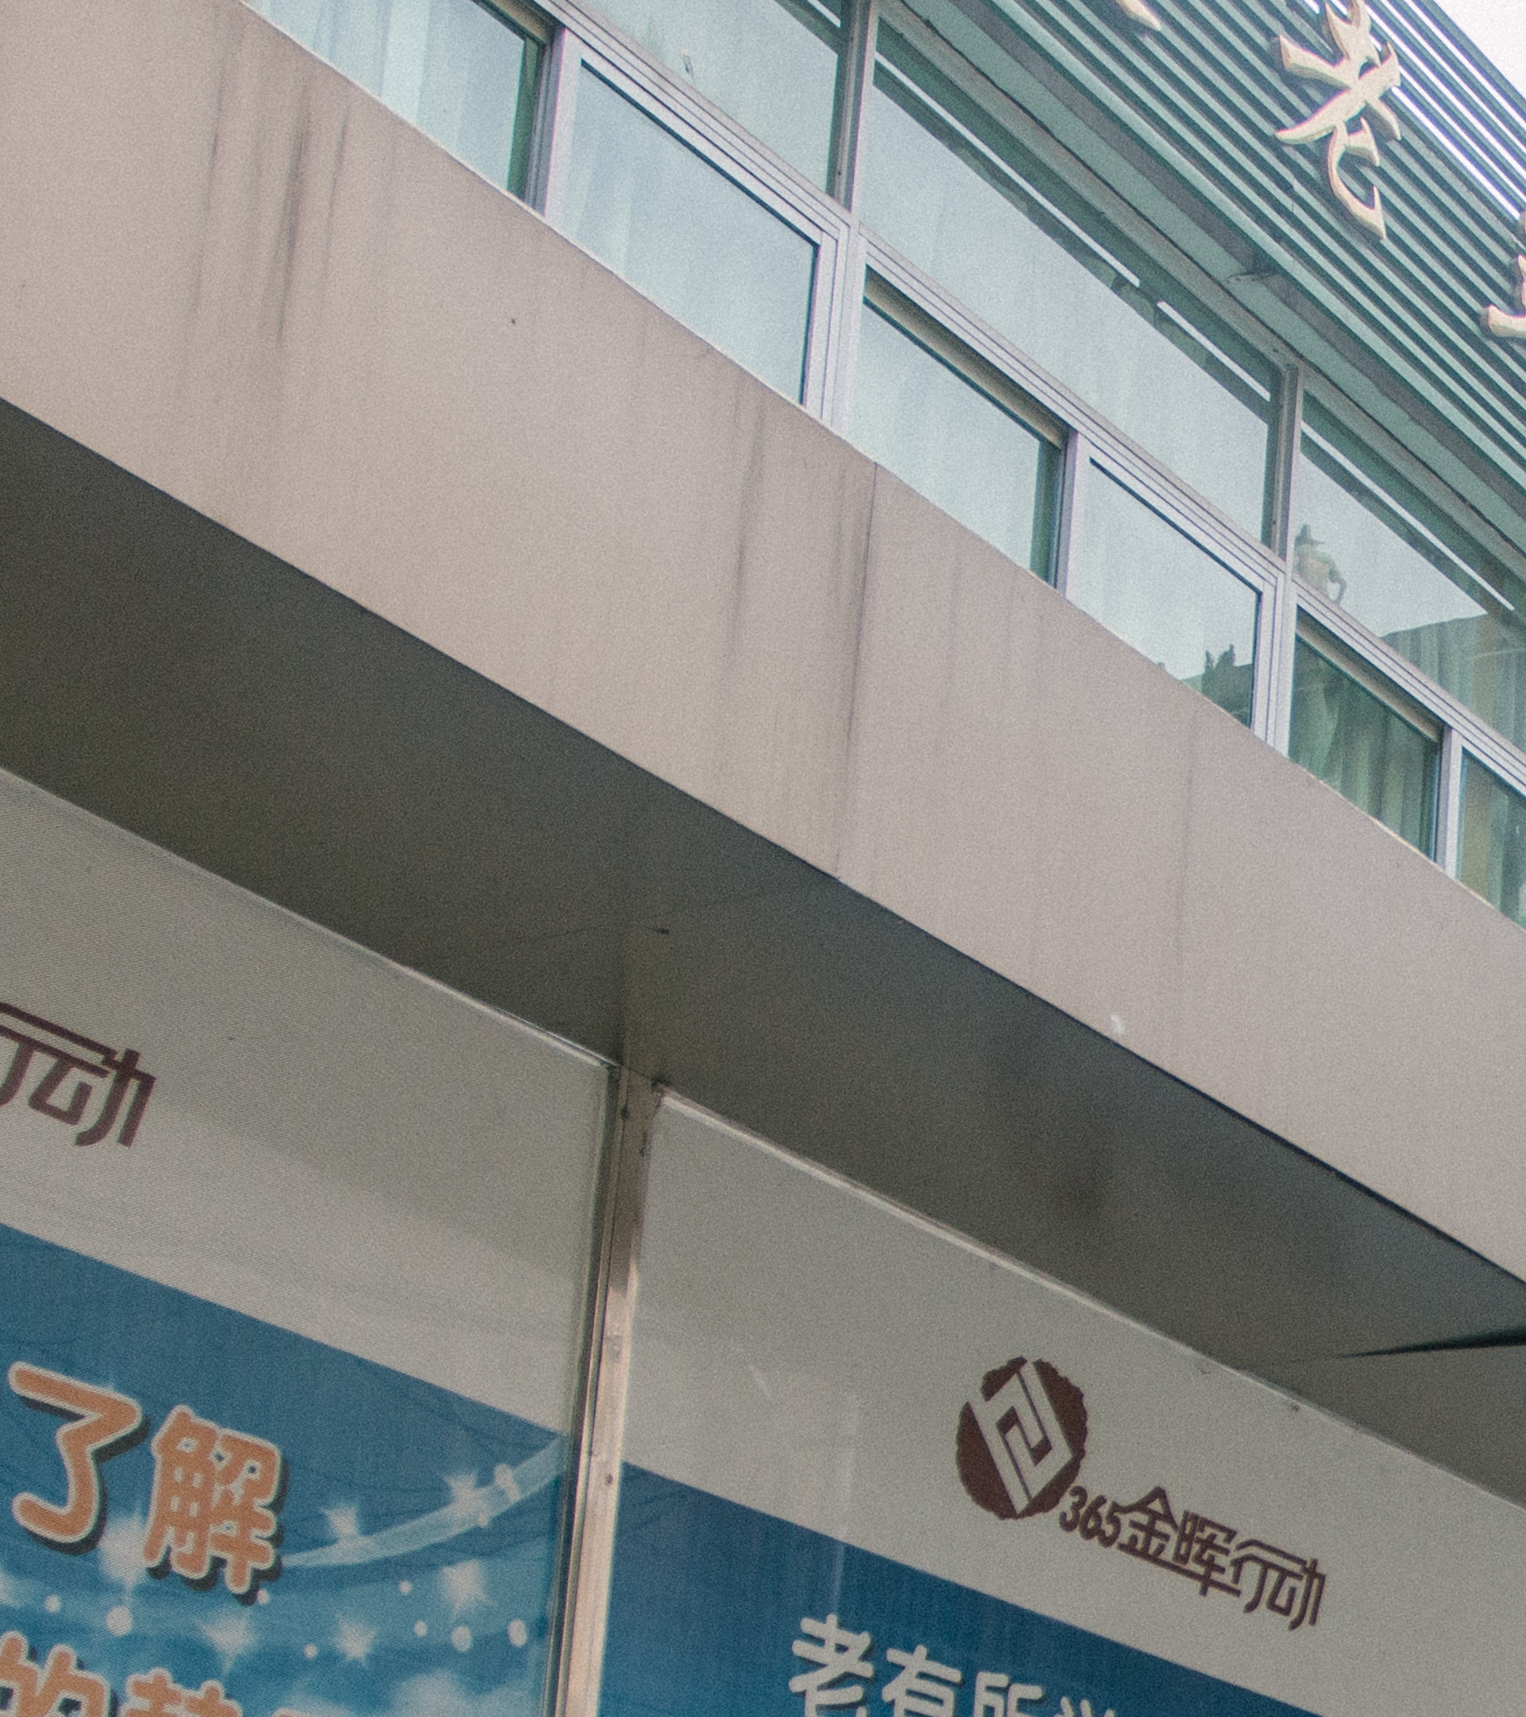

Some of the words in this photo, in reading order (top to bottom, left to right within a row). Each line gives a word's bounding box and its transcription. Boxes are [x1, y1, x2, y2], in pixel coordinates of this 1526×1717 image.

[9, 1361, 285, 1597] 了解
[1059, 1486, 1326, 1630] 365金晖行动
